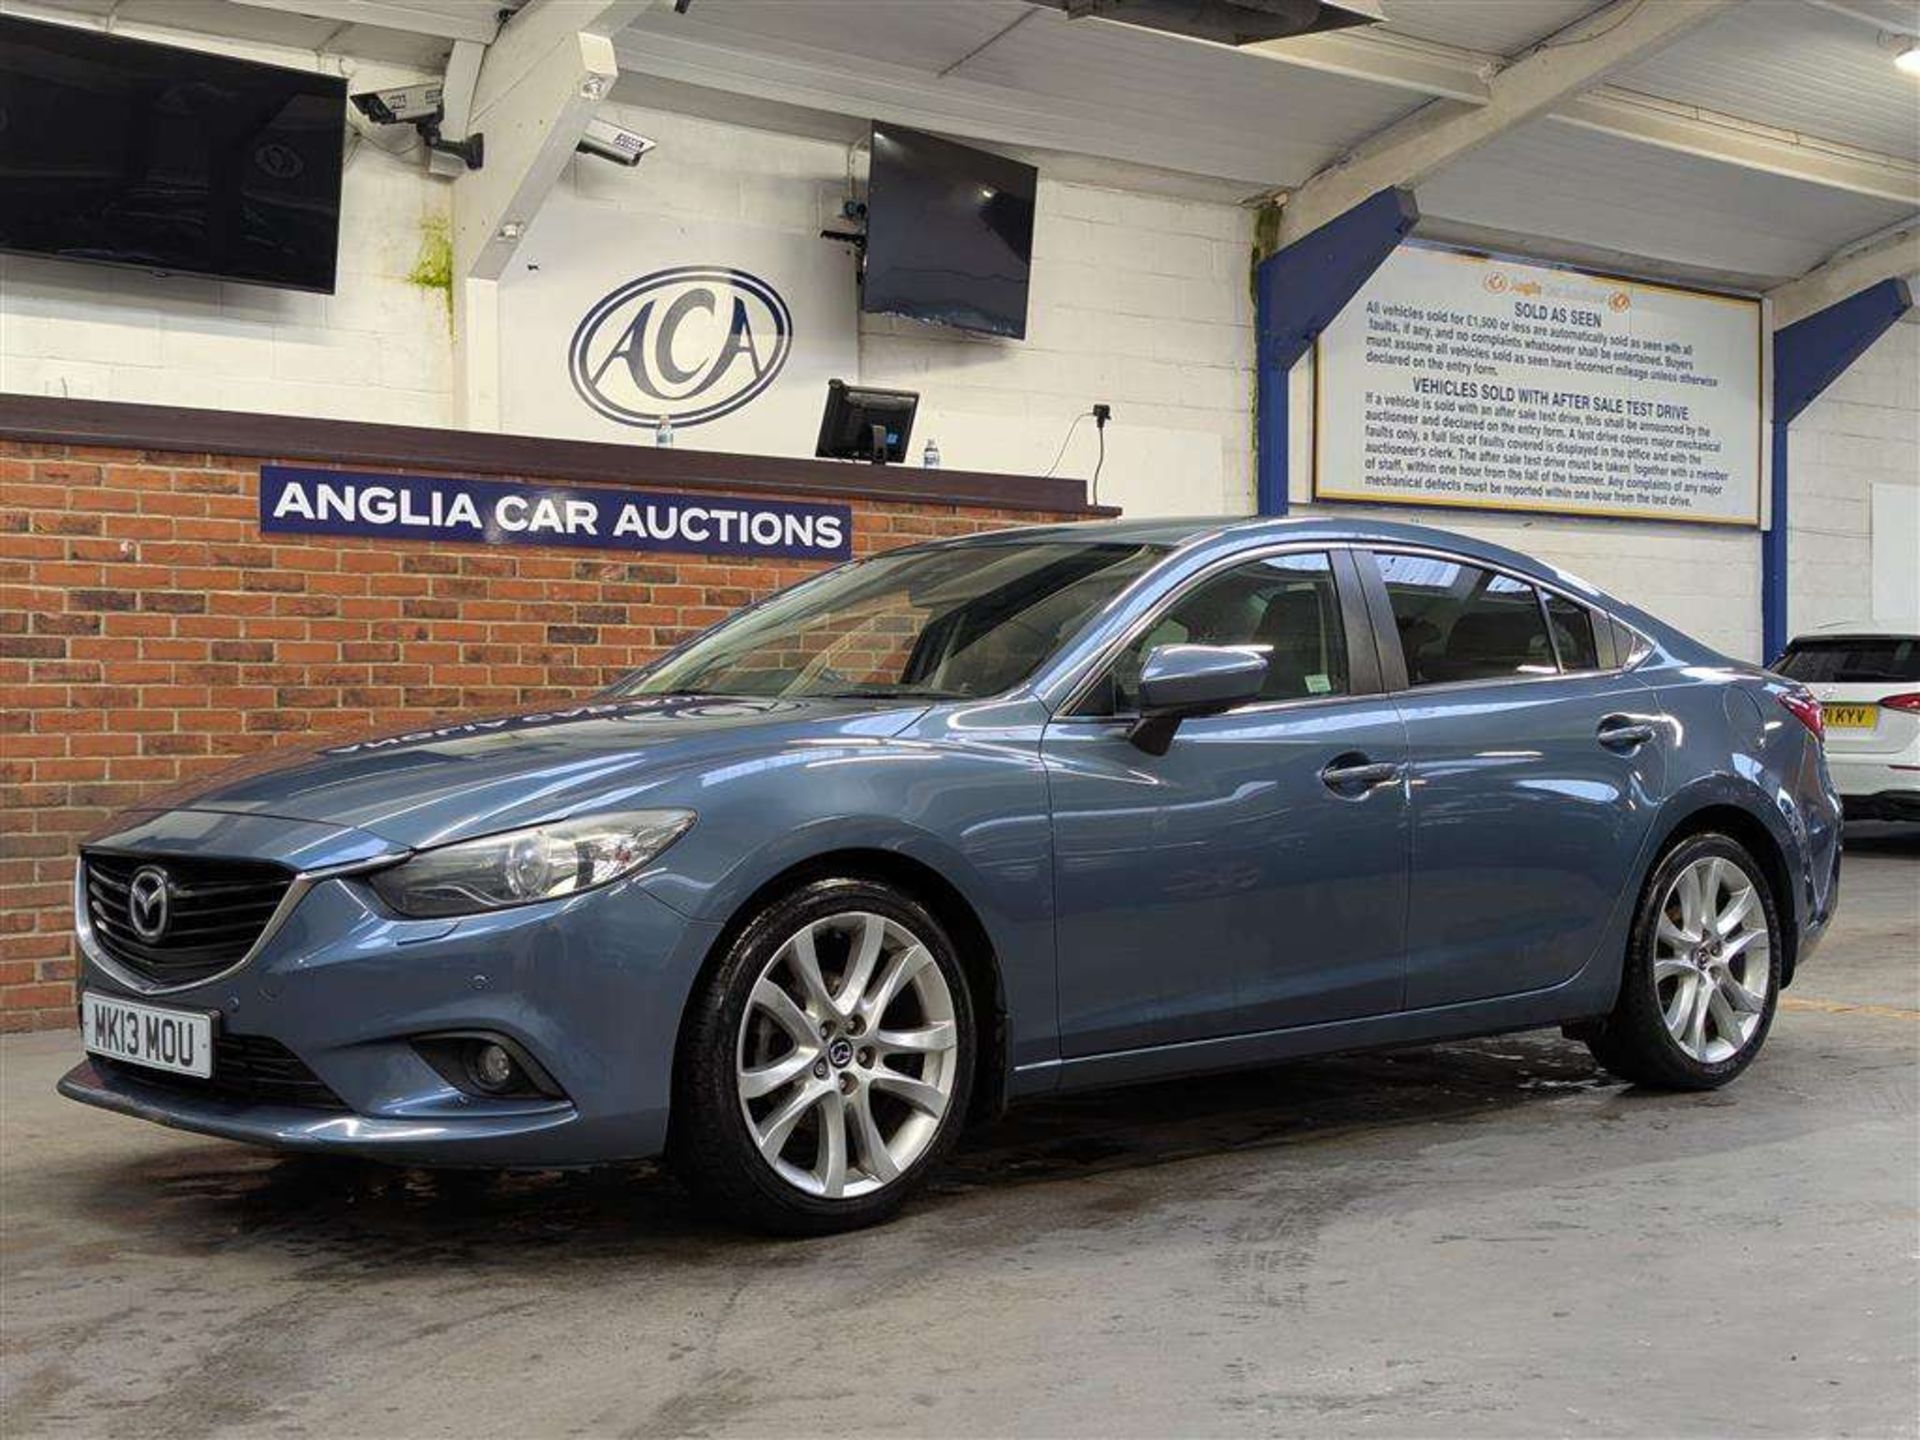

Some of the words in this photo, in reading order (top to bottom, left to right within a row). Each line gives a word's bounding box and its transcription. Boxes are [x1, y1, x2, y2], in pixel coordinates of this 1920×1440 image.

[1366, 300, 1379, 314] All
[1383, 302, 1423, 320] vehicles
[1427, 308, 1447, 323] sold
[1450, 311, 1464, 325] for
[1500, 321, 1508, 331] or
[1512, 320, 1530, 334] less
[1533, 326, 1547, 336] are
[1550, 325, 1607, 346] automatically
[1610, 333, 1627, 347] sold
[1630, 339, 1640, 348] as
[1643, 340, 1662, 351] seen
[1664, 341, 1680, 354] with
[1683, 343, 1692, 355] all
[1514, 302, 1548, 320] SOLD
[1551, 307, 1567, 324] AS
[1570, 311, 1602, 328] SEEN
[590, 288, 762, 400] ACA
[1366, 349, 1410, 366] declared
[1413, 357, 1424, 368] on
[1428, 357, 1443, 370] the
[1446, 359, 1471, 375] entry
[1367, 334, 1391, 348] must
[1395, 339, 1432, 353] assume
[1436, 342, 1447, 354] all
[1449, 344, 1489, 359] vehicles
[1492, 349, 1511, 362] sold
[1515, 354, 1524, 363] as
[1528, 355, 1548, 366] seen
[1551, 356, 1571, 369] have
[1574, 359, 1612, 374] incorrect
[1615, 364, 1648, 381] mileage
[1650, 369, 1675, 381] unless
[1680, 372, 1717, 386] otherwise
[1403, 322, 1409, 334] if
[1436, 326, 1453, 339] and
[1457, 331, 1468, 341] no
[1472, 331, 1521, 350] complaints
[1525, 338, 1575, 355] whatsoever
[1579, 344, 1598, 357] shall
[1601, 347, 1610, 359] be
[1665, 355, 1693, 371] Buyers
[1365, 391, 1372, 404] If
[1385, 393, 1419, 408] vehicle
[1422, 397, 1430, 409] is
[1434, 398, 1455, 412] sold
[1458, 401, 1477, 414] with
[1481, 405, 1492, 415] an
[1494, 404, 1515, 418] after
[1518, 407, 1535, 420] sale
[1539, 409, 1555, 422] test
[1585, 414, 1601, 426] this
[1604, 416, 1623, 428] shall
[1627, 418, 1636, 430] be
[1640, 419, 1683, 434] announced
[1686, 424, 1695, 437] by
[1698, 425, 1709, 437] the
[1413, 376, 1477, 398] VEHICLES
[1480, 384, 1514, 402] SOLD
[1518, 388, 1548, 405] WITH
[1552, 392, 1589, 410] AFTER
[1593, 396, 1622, 413] SALE
[1626, 400, 1652, 416] TEST
[1657, 403, 1688, 420] DRIVE
[1365, 408, 1417, 424] auctioneer
[1422, 413, 1438, 426] and
[1442, 415, 1484, 430] declared
[1487, 422, 1497, 431] on
[1501, 421, 1514, 433] the
[1518, 422, 1540, 437] entry
[1577, 428, 1593, 440] test
[1596, 430, 1617, 442] drive
[1620, 434, 1647, 445] covers
[1651, 435, 1673, 449] major
[1676, 437, 1720, 451] mechanical
[1366, 424, 1393, 438] faults
[1431, 429, 1446, 442] full
[1449, 431, 1464, 444] list
[1466, 433, 1476, 445] of
[1479, 434, 1504, 447] faults
[1508, 436, 1543, 451] covered
[1546, 440, 1554, 452] is
[1556, 441, 1598, 457] displayed
[1601, 445, 1609, 456] in
[1610, 446, 1623, 457] the
[1627, 447, 1650, 460] office
[1653, 449, 1667, 461] and
[1670, 451, 1686, 463] with
[1689, 453, 1700, 464] the
[1364, 456, 1374, 468] of
[1406, 459, 1436, 473] within
[1438, 464, 1456, 474] one
[1458, 463, 1481, 476] hour
[1484, 465, 1505, 478] from
[1507, 467, 1521, 479] the
[1524, 468, 1538, 480] fall
[1541, 469, 1549, 481] of
[1552, 470, 1565, 482] the
[1608, 475, 1623, 488] Any
[1626, 476, 1670, 492] complaints
[1674, 480, 1682, 491] of
[1684, 483, 1697, 494] any
[1700, 482, 1722, 495] major
[1459, 448, 1475, 460] The
[1480, 449, 1500, 462] after
[1503, 451, 1521, 464] sale
[1524, 453, 1541, 466] test
[1543, 455, 1565, 467] drive
[1568, 457, 1589, 469] must
[1593, 459, 1603, 470] be
[1634, 462, 1668, 477] together
[1671, 466, 1687, 477] with
[1697, 468, 1728, 480] member
[1364, 472, 1422, 488] mechanical
[1425, 476, 1460, 490] defects
[1464, 479, 1487, 492] must
[1490, 481, 1500, 493] be
[1504, 482, 1542, 498] reported
[1546, 485, 1571, 498] within
[1575, 490, 1589, 499] one
[1591, 488, 1611, 500] hour
[1613, 490, 1633, 502] from
[1636, 492, 1649, 503] the
[1652, 493, 1667, 504] test
[273, 482, 483, 529] ANGLIA
[495, 495, 598, 536] CAR
[613, 503, 843, 549] AUCTIONS
[94, 1004, 139, 1055] MK13
[146, 1015, 194, 1067] MOU
